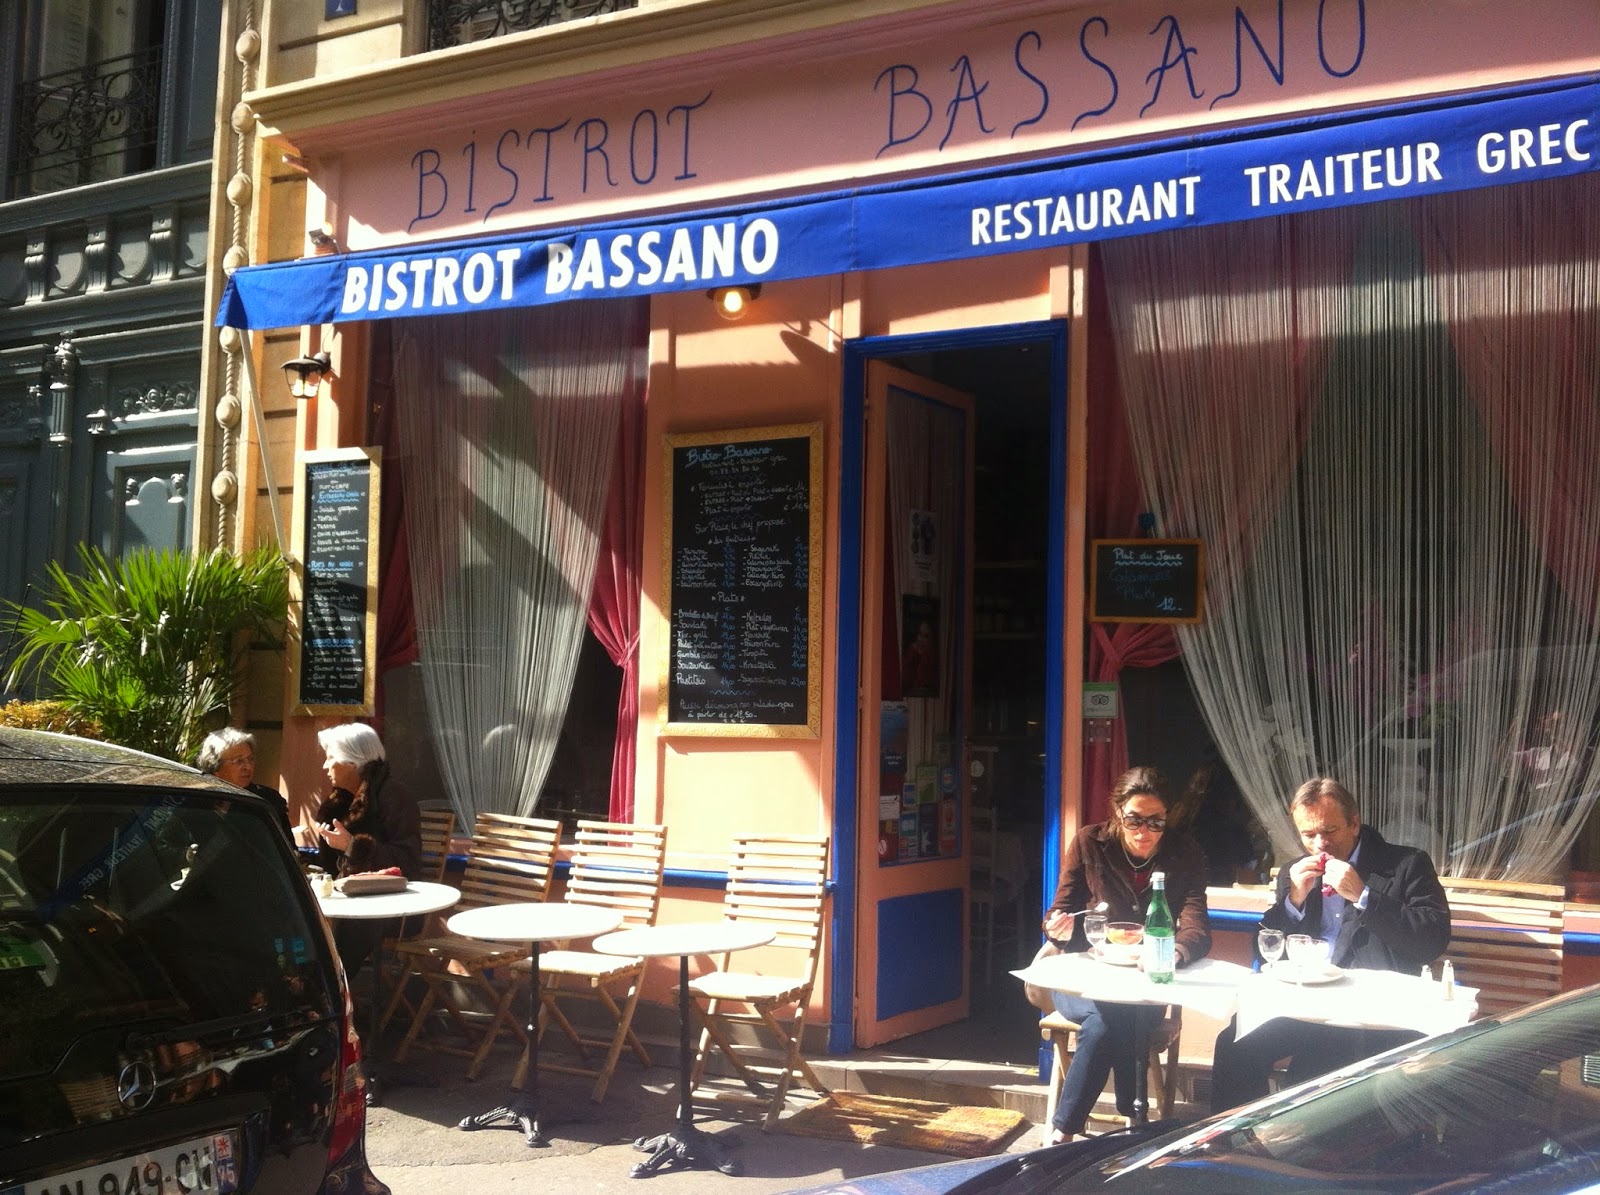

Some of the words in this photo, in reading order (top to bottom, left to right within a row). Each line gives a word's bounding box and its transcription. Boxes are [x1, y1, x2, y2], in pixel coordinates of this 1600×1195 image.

[874, 0, 1366, 160] BASSANO
[971, 176, 1201, 246] RESTAURANT
[1244, 142, 1443, 207] TRAITEUR
[1477, 119, 1590, 174] GREC
[341, 248, 521, 314] BISTROT
[545, 218, 779, 294] BASSANO
[1113, 547, 1134, 560] Plat
[1139, 551, 1153, 560] du
[1156, 549, 1183, 560] Jour
